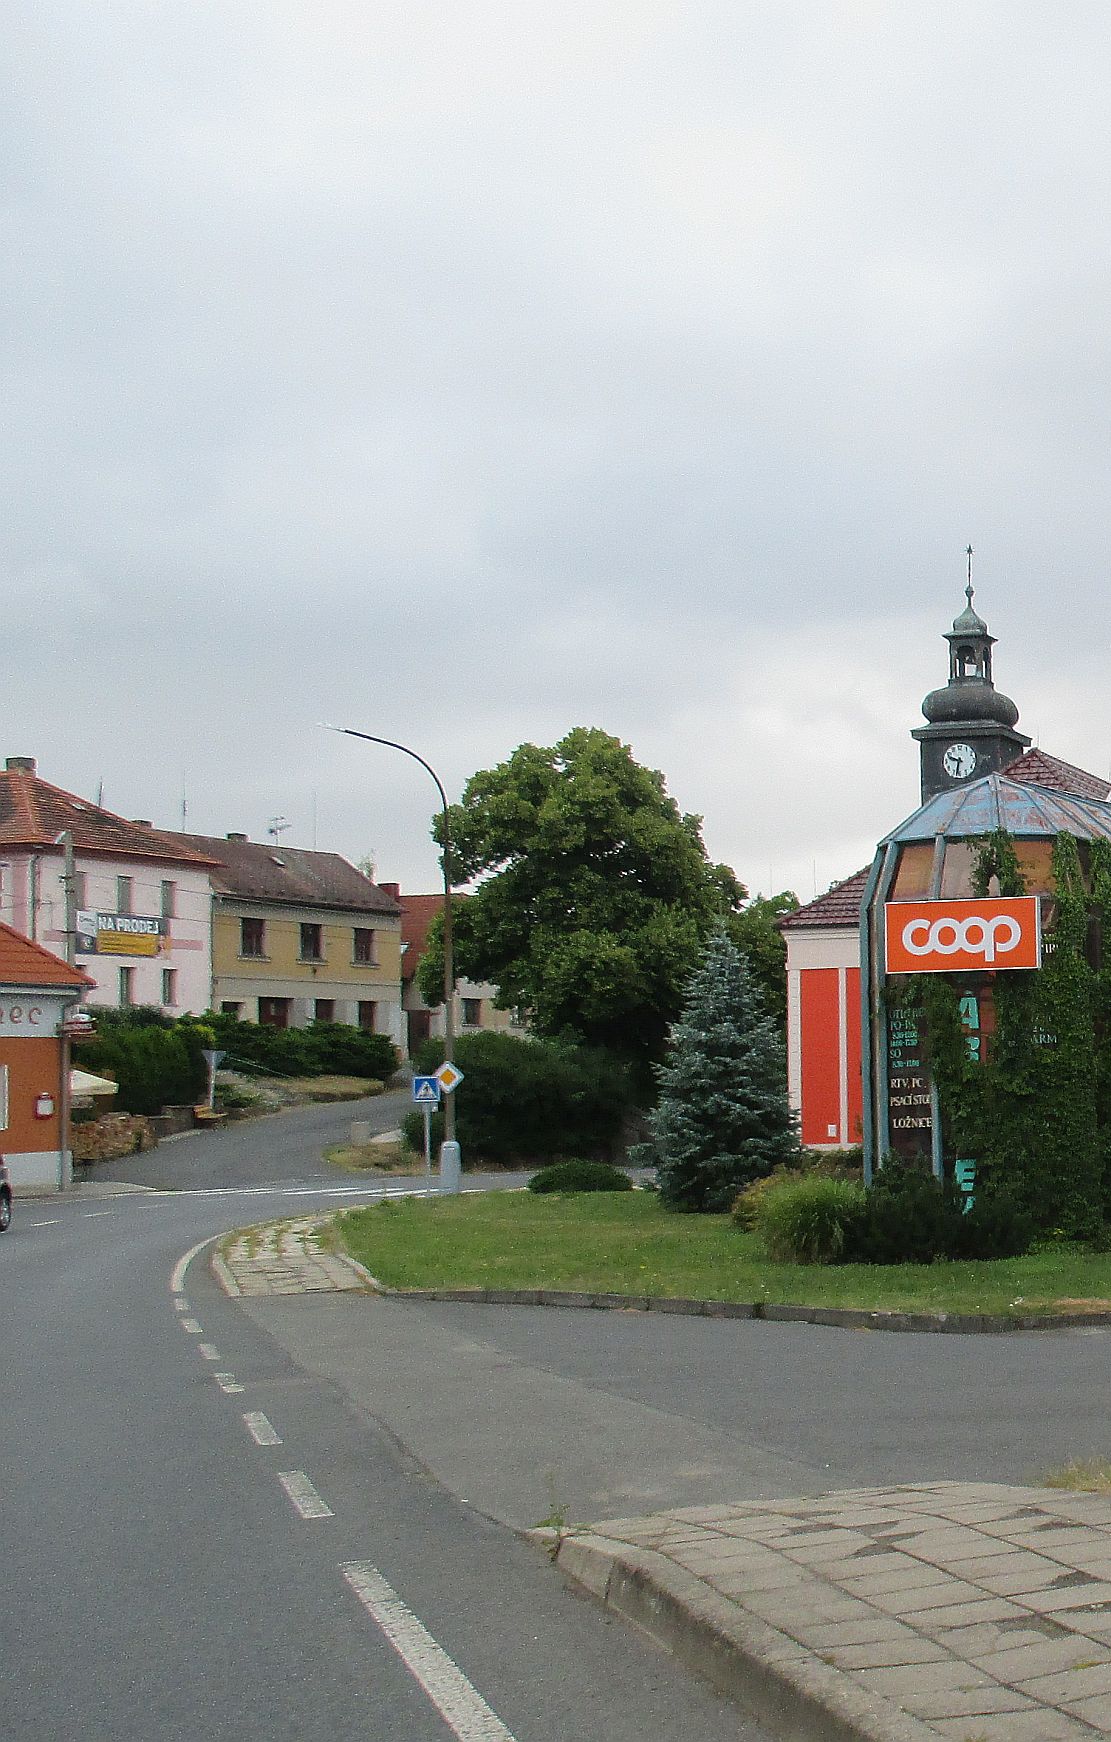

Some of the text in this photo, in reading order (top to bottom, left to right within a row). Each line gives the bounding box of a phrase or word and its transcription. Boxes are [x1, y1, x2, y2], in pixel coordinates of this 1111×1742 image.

[98, 916, 115, 930] NA
[116, 918, 159, 935] PRODEJ
[902, 915, 1022, 962] coop
